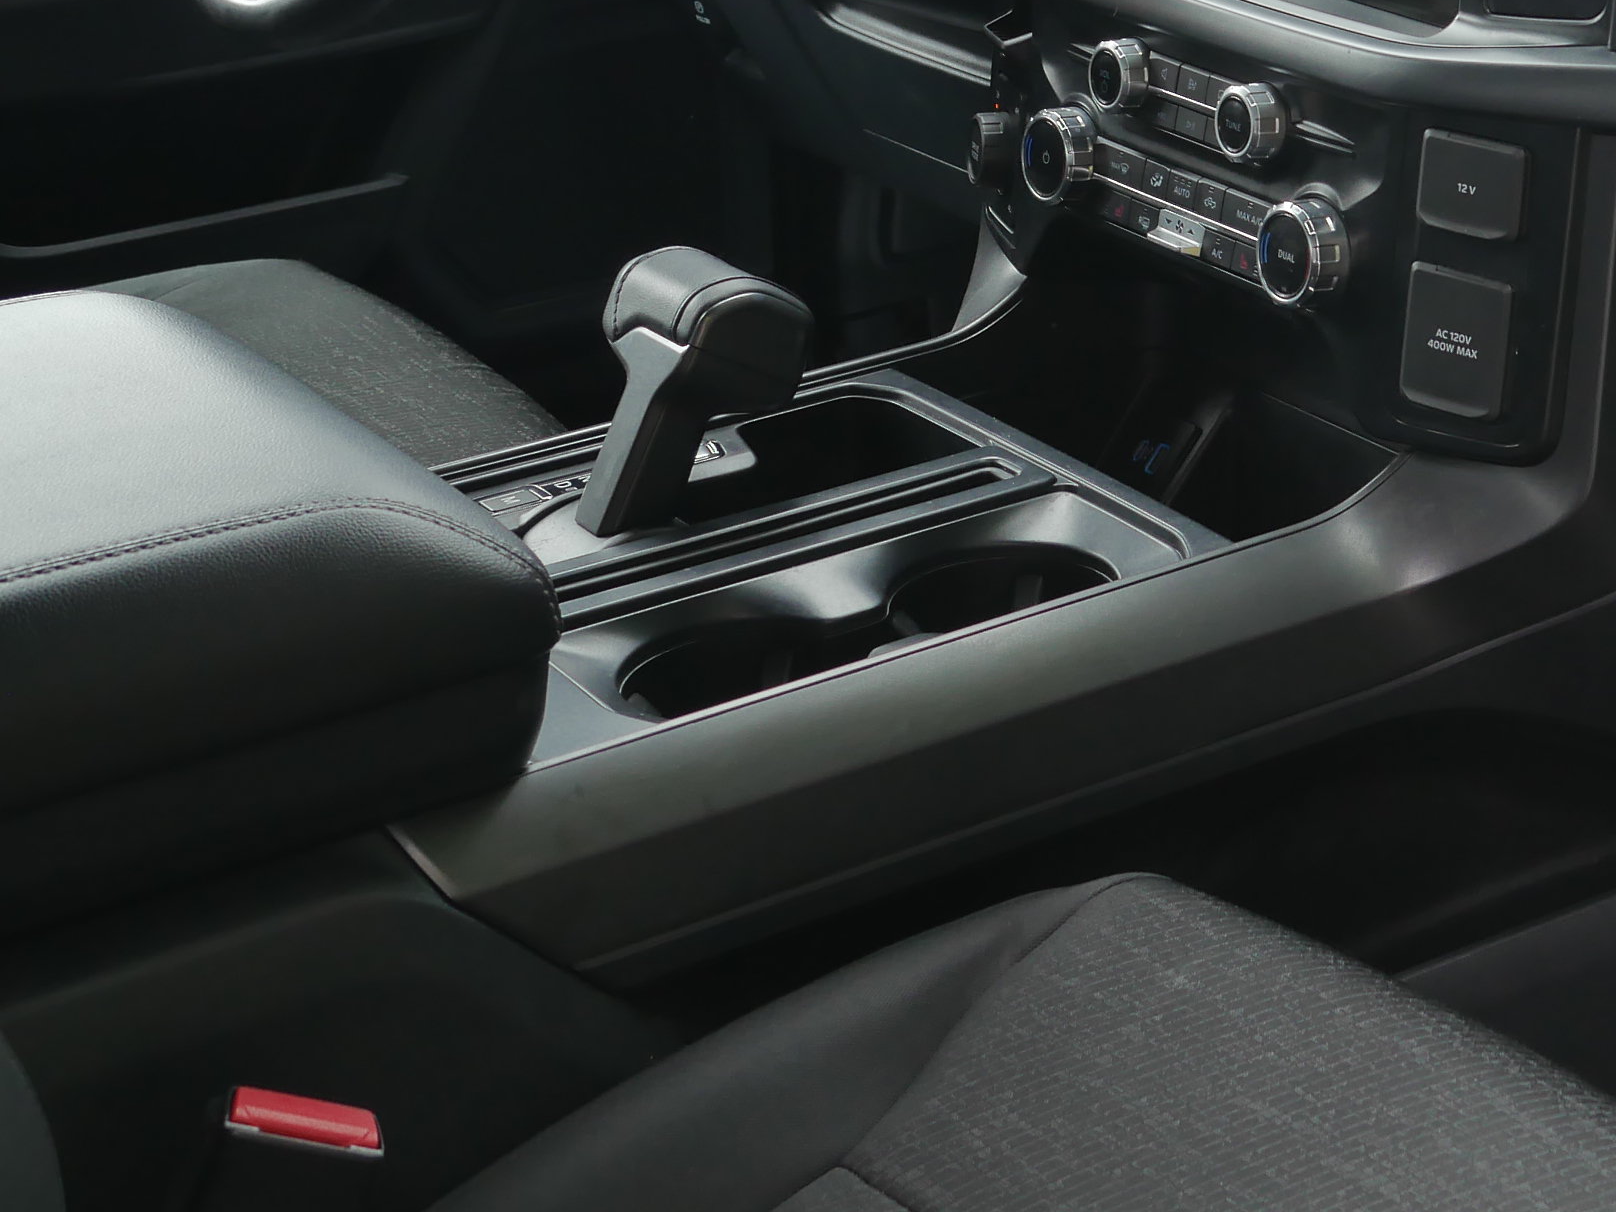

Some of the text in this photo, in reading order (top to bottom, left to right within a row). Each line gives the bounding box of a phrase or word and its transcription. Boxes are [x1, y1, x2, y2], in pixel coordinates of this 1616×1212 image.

[1225, 118, 1241, 132] TUNE
[1173, 186, 1190, 199] AUTO
[1457, 183, 1468, 194] 12
[1236, 209, 1250, 221] MAX
[1211, 247, 1223, 260] A/C
[1277, 248, 1295, 264] DUAL
[1436, 328, 1472, 345] AC 120V
[1427, 339, 1478, 359] 400W MAX
